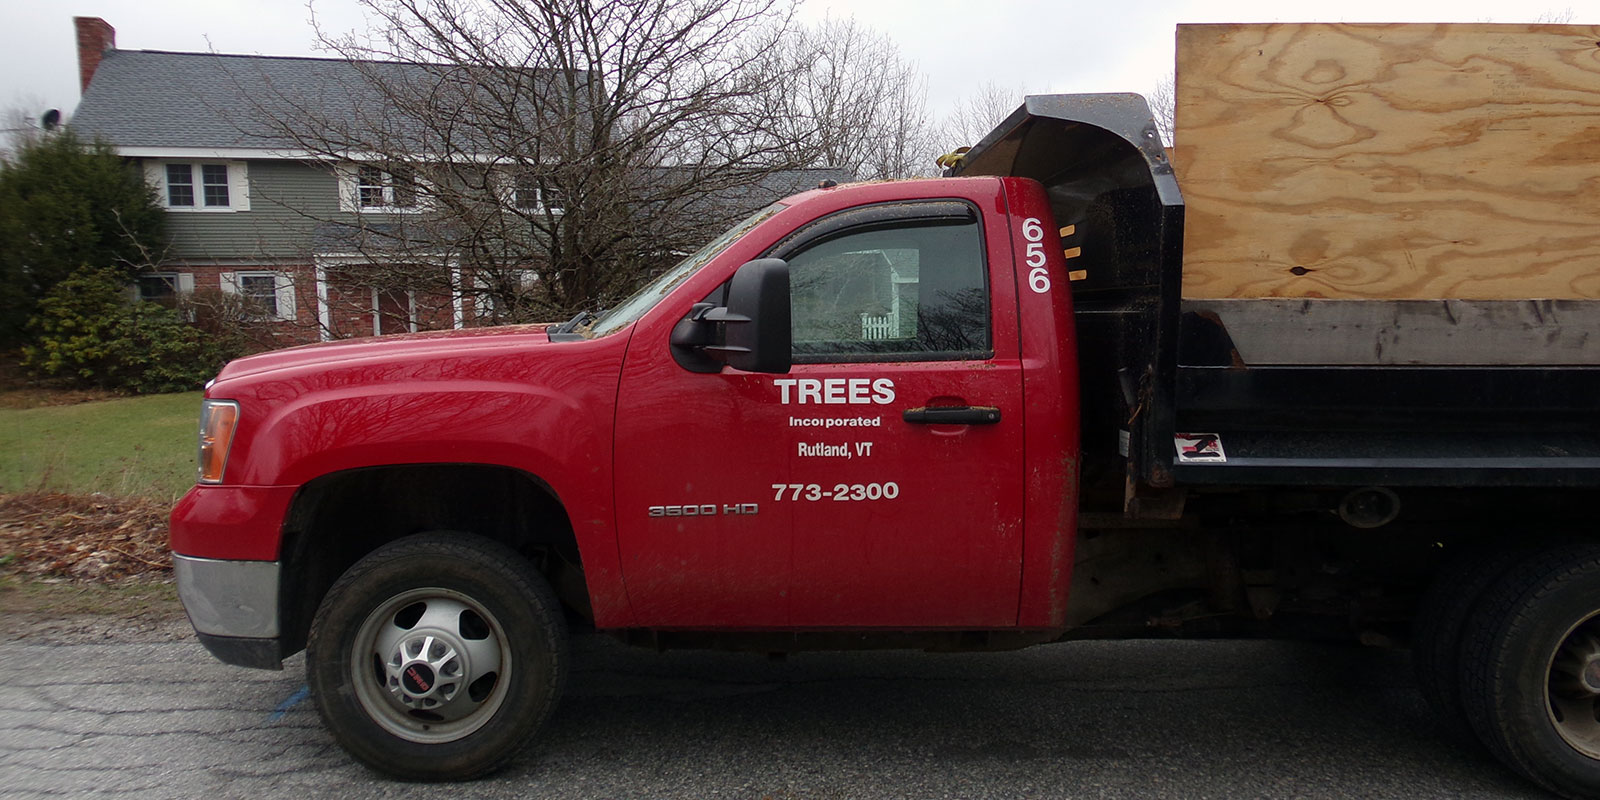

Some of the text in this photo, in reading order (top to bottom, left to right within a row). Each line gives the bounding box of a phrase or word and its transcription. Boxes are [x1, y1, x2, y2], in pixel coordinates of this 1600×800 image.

[1022, 217, 1051, 294] 656
[773, 378, 896, 405] TREES
[798, 442, 873, 460] Rutland, VT
[771, 482, 900, 502] 773-2300
[648, 503, 759, 517] 3500 HD
[406, 667, 430, 692] GMC
